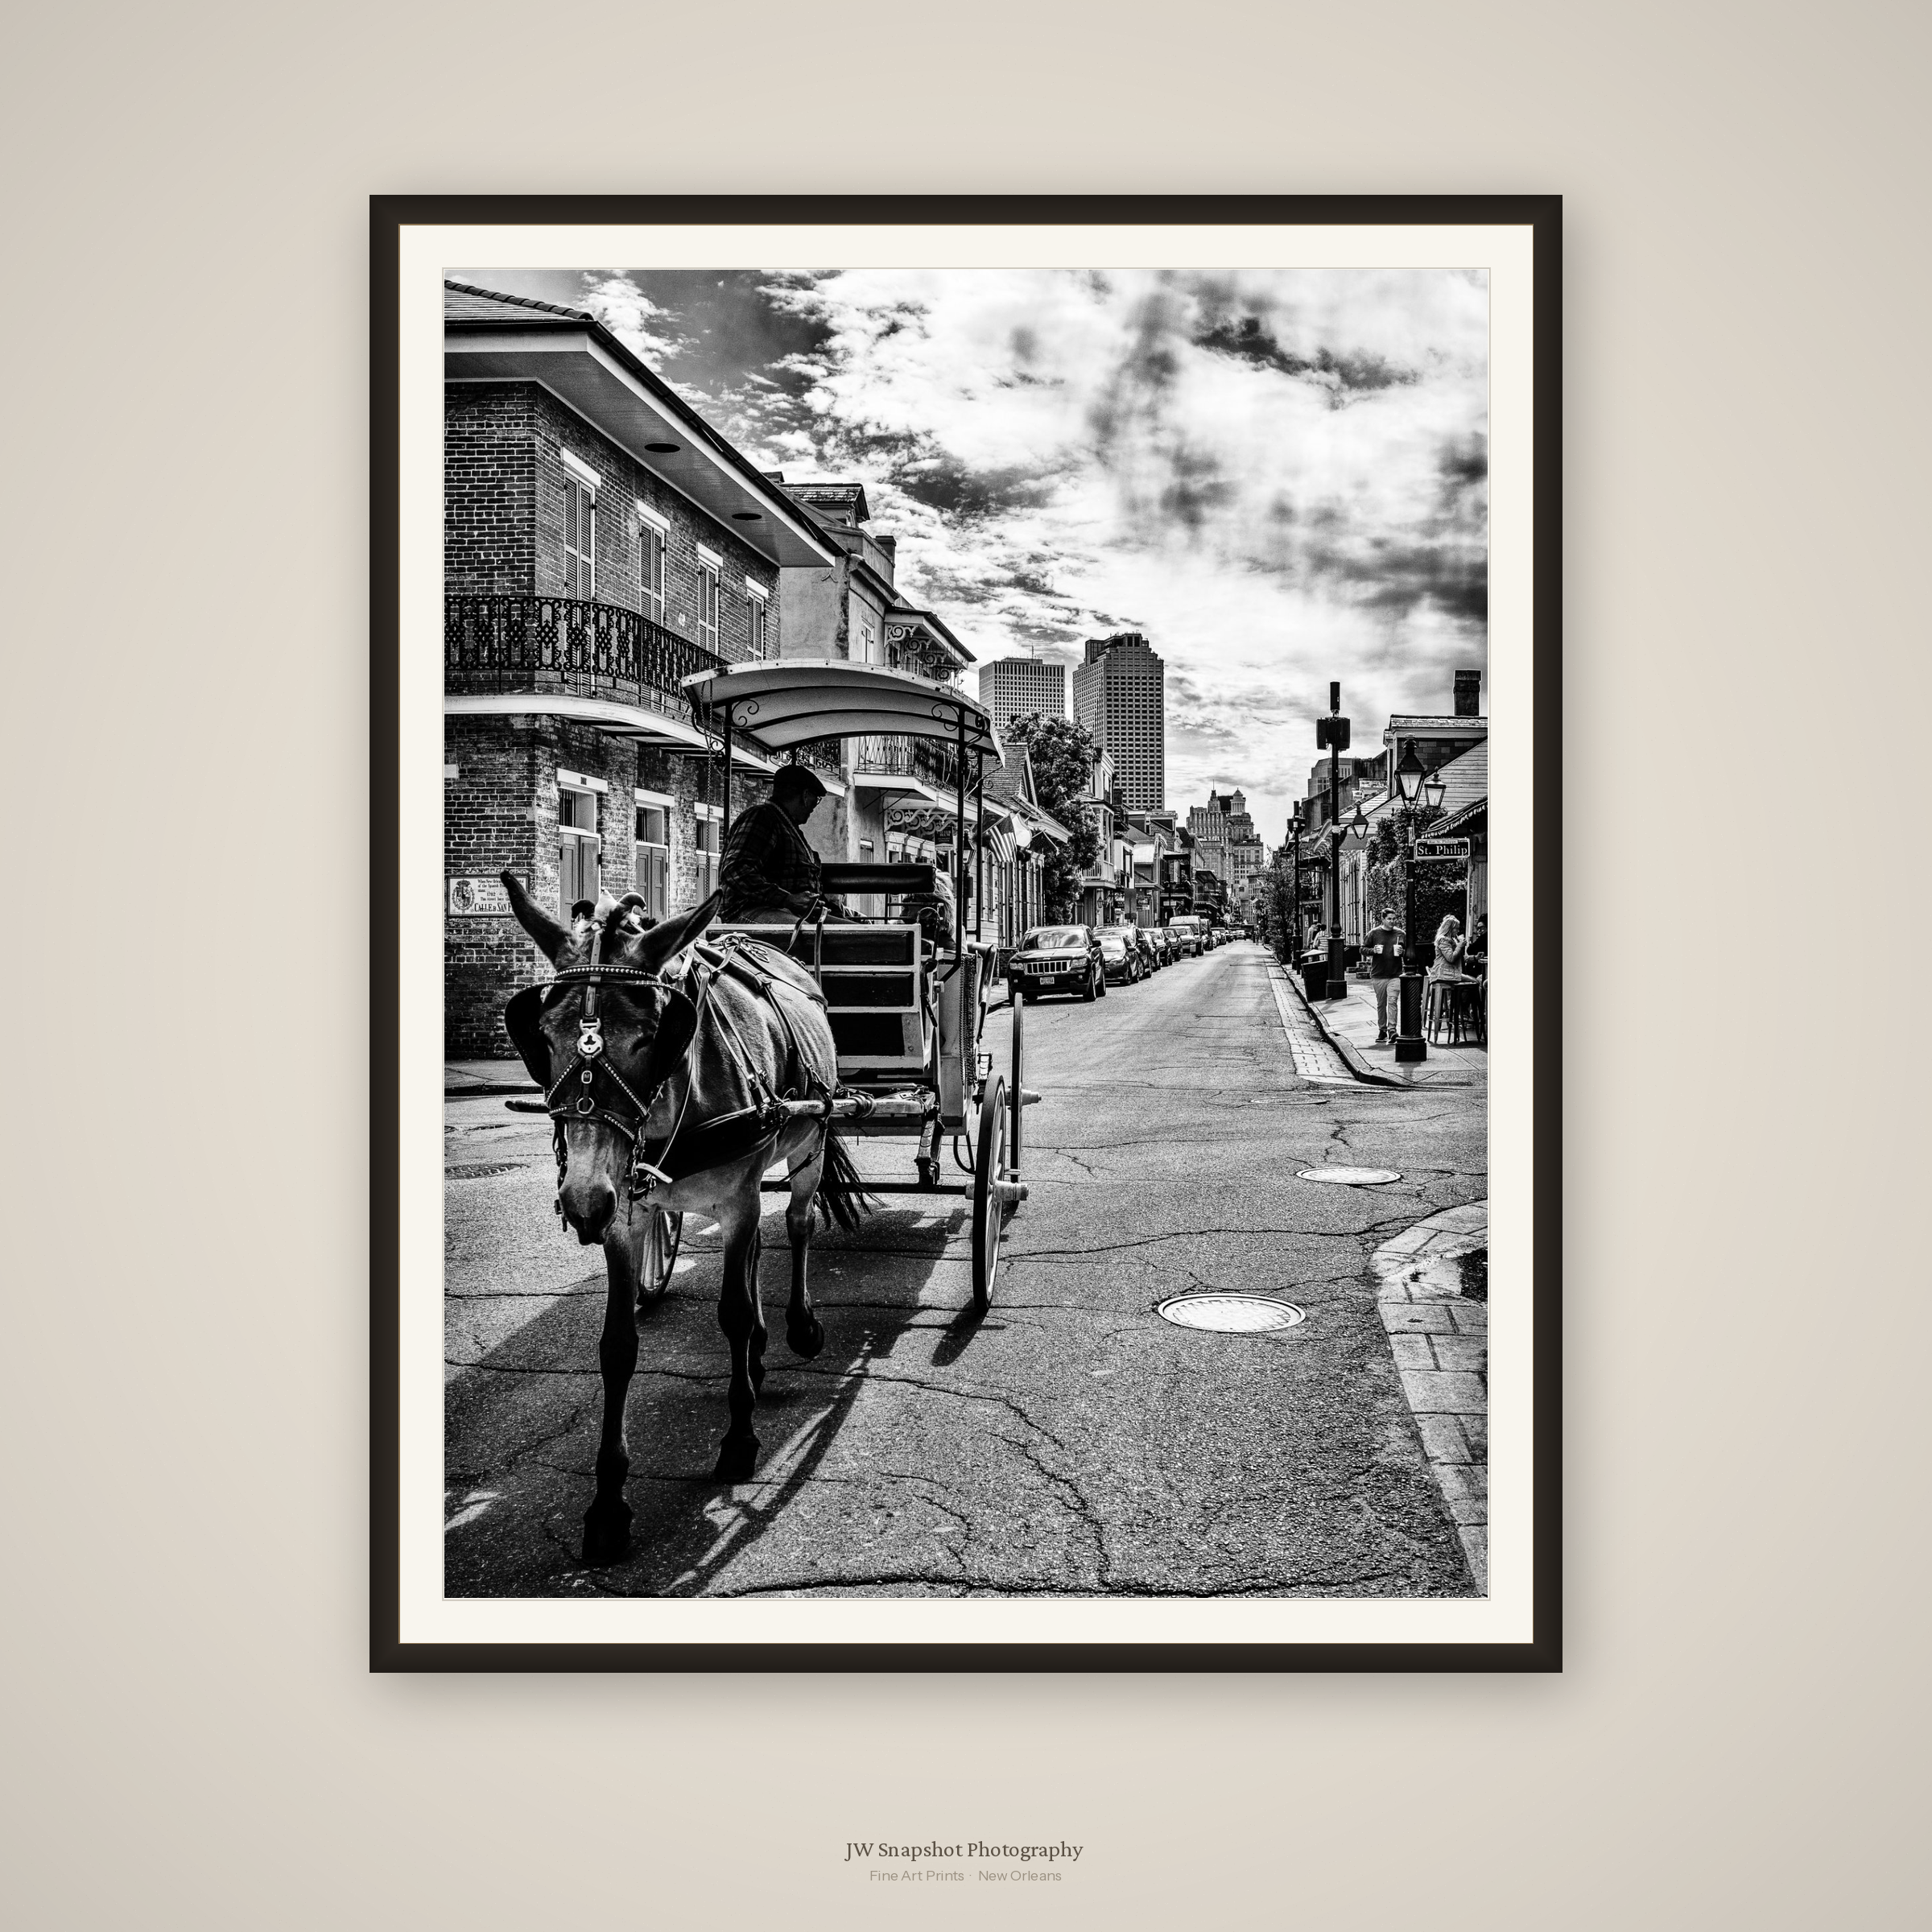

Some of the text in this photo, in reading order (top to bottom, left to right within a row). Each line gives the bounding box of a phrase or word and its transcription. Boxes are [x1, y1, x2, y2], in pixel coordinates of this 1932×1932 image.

[1418, 844, 1468, 857] St. Philip
[497, 902, 507, 912] SAN
